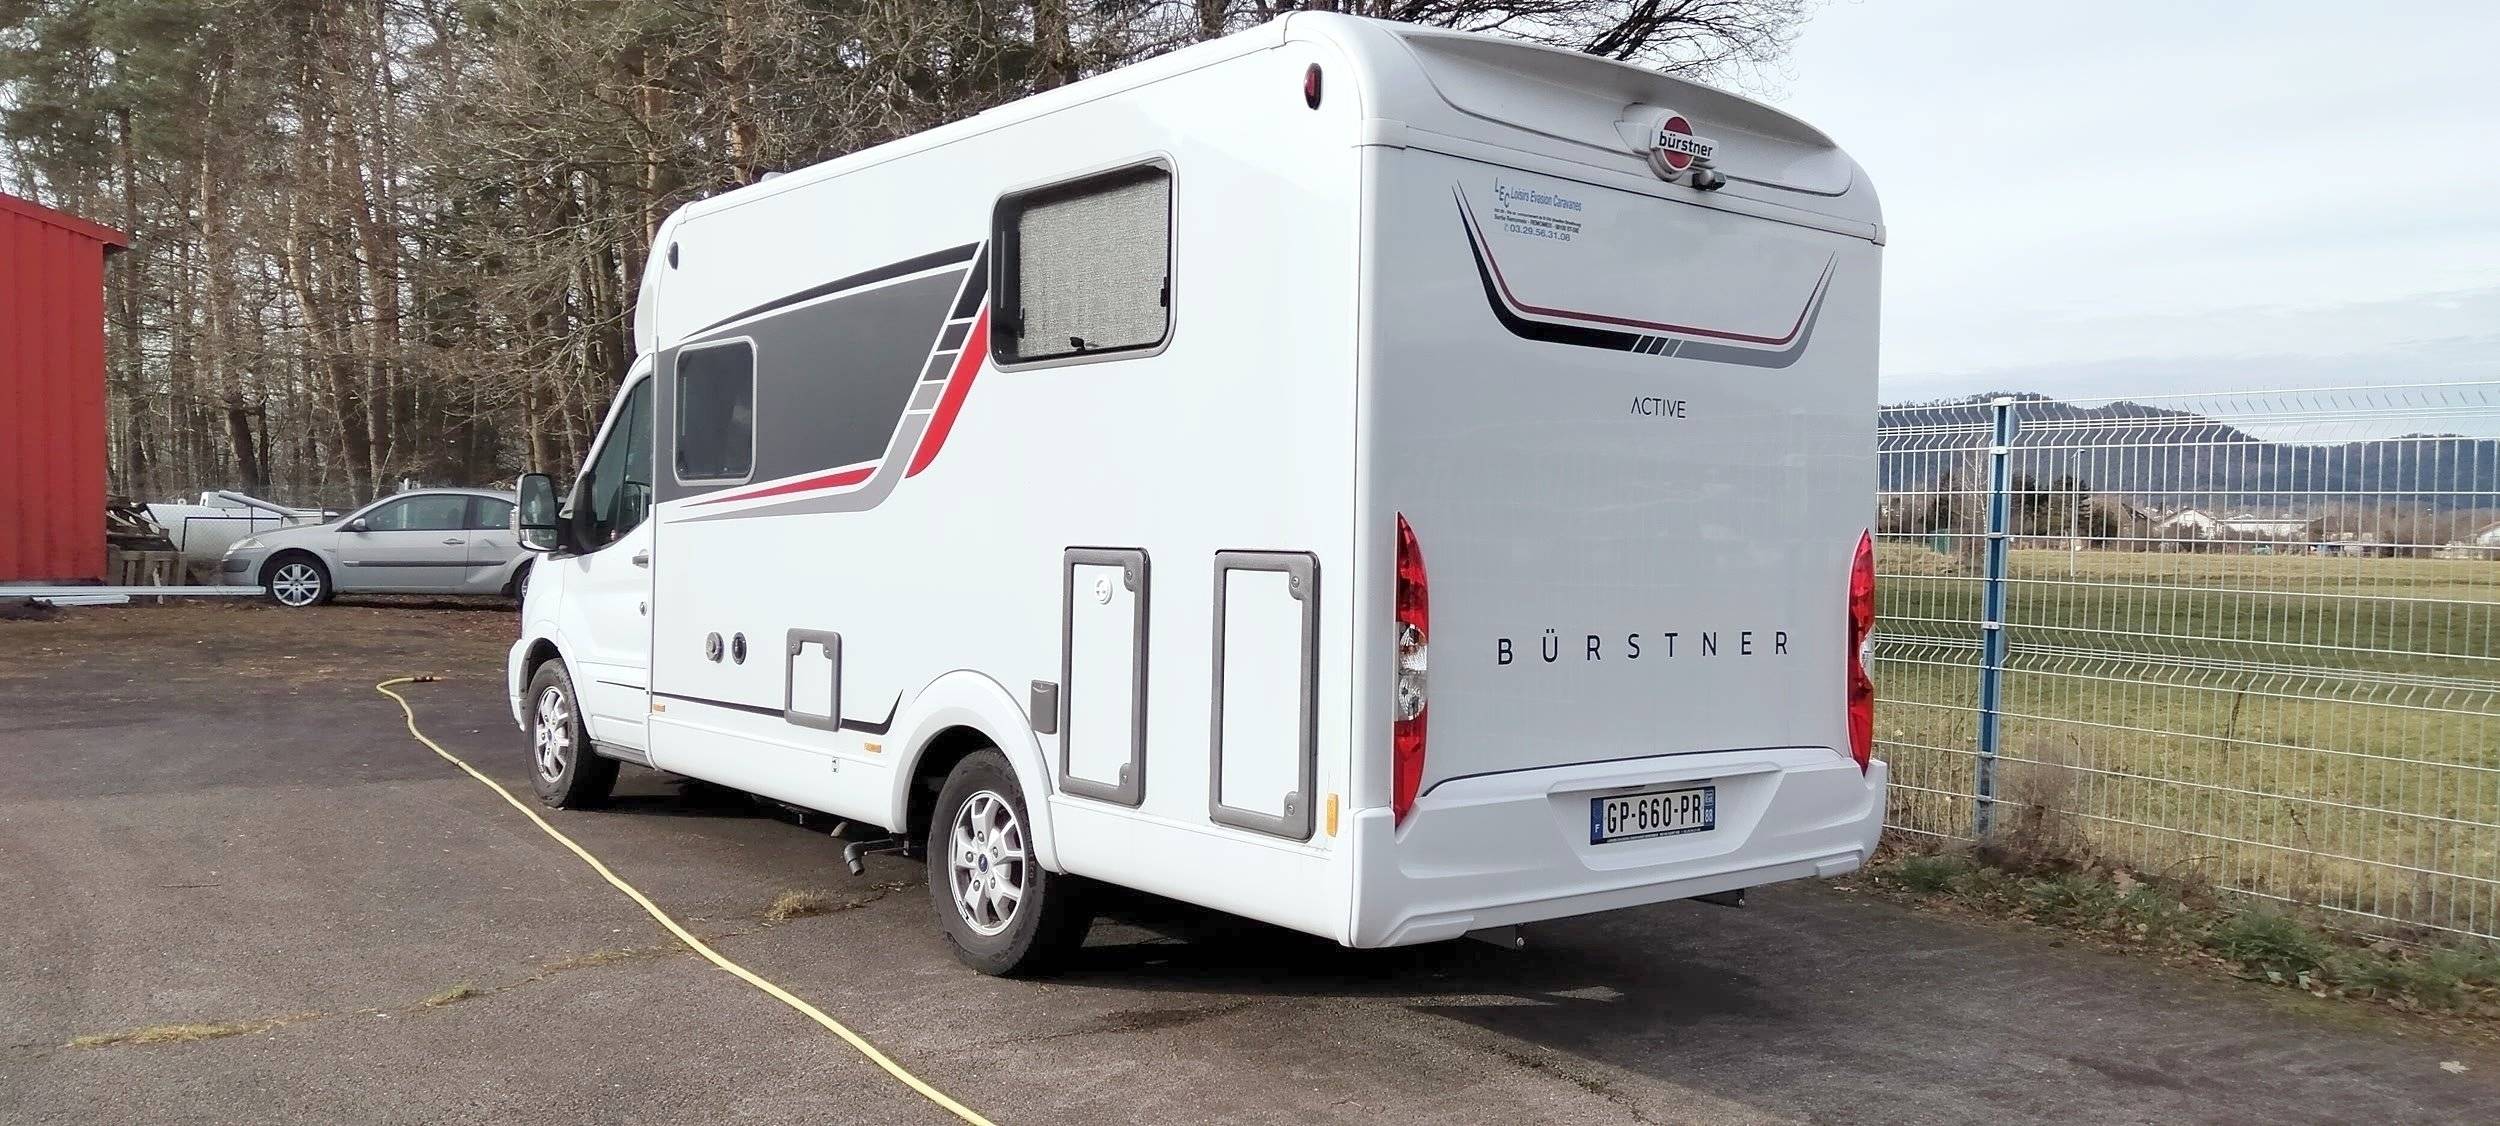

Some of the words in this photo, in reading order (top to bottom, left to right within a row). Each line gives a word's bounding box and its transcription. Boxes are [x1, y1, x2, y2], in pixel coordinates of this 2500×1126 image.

[1658, 131, 1713, 157] bürstner
[1510, 187, 1530, 203] Loisirs
[1530, 190, 1553, 206] Evasion
[1553, 195, 1582, 212] Caravanes
[1631, 396, 1687, 419] ACTIVE
[1497, 628, 1788, 666] BÜRSTNER
[1594, 823, 1601, 833] F
[1607, 794, 1702, 834] GP-660-PR
[1704, 808, 1714, 823] 88
